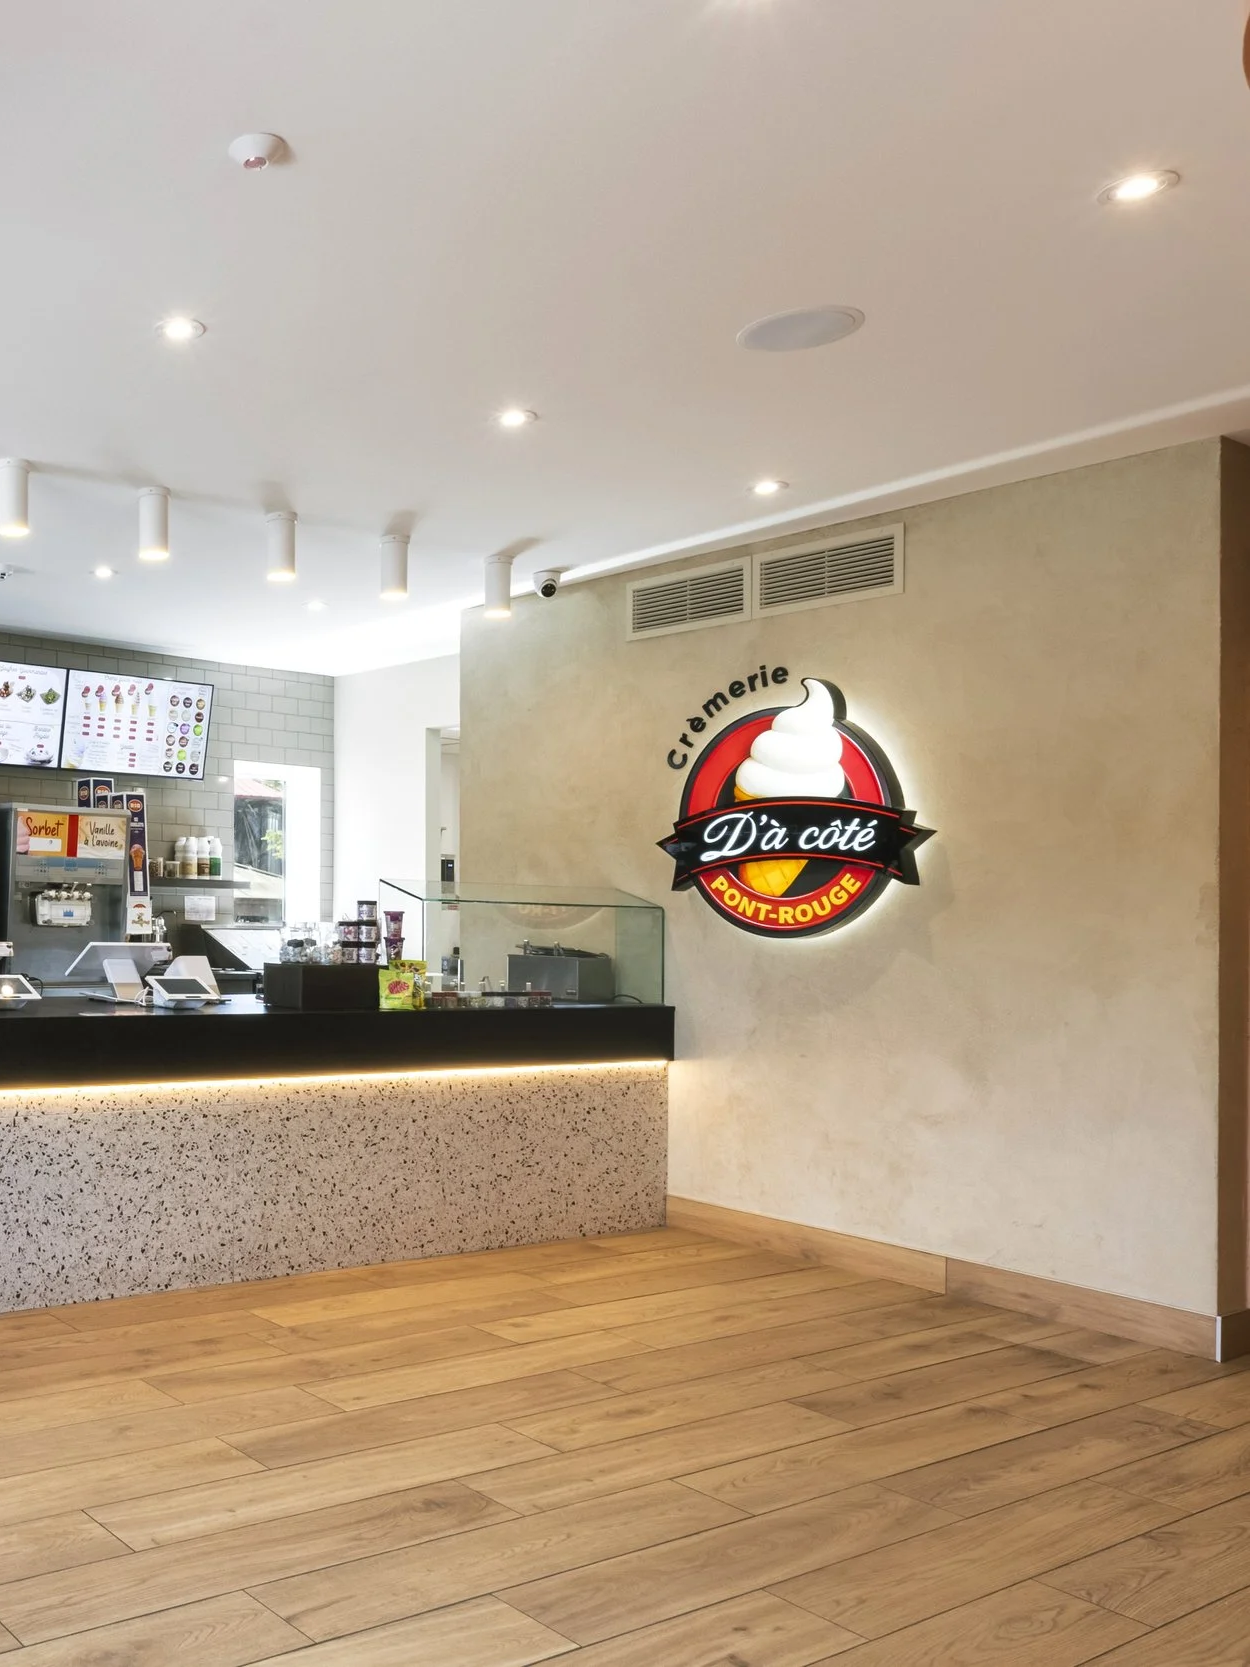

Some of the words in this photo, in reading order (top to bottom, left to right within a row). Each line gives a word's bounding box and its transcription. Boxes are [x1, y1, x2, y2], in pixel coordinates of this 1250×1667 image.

[667, 664, 789, 770] Crèmerie
[26, 817, 64, 836] Sorbet
[83, 838, 89, 846] à
[92, 835, 119, 848] l'avoine
[89, 821, 115, 835] Vanille
[700, 811, 789, 861] D'à
[799, 818, 878, 852] côté
[710, 873, 861, 924] PONT-ROUGE
